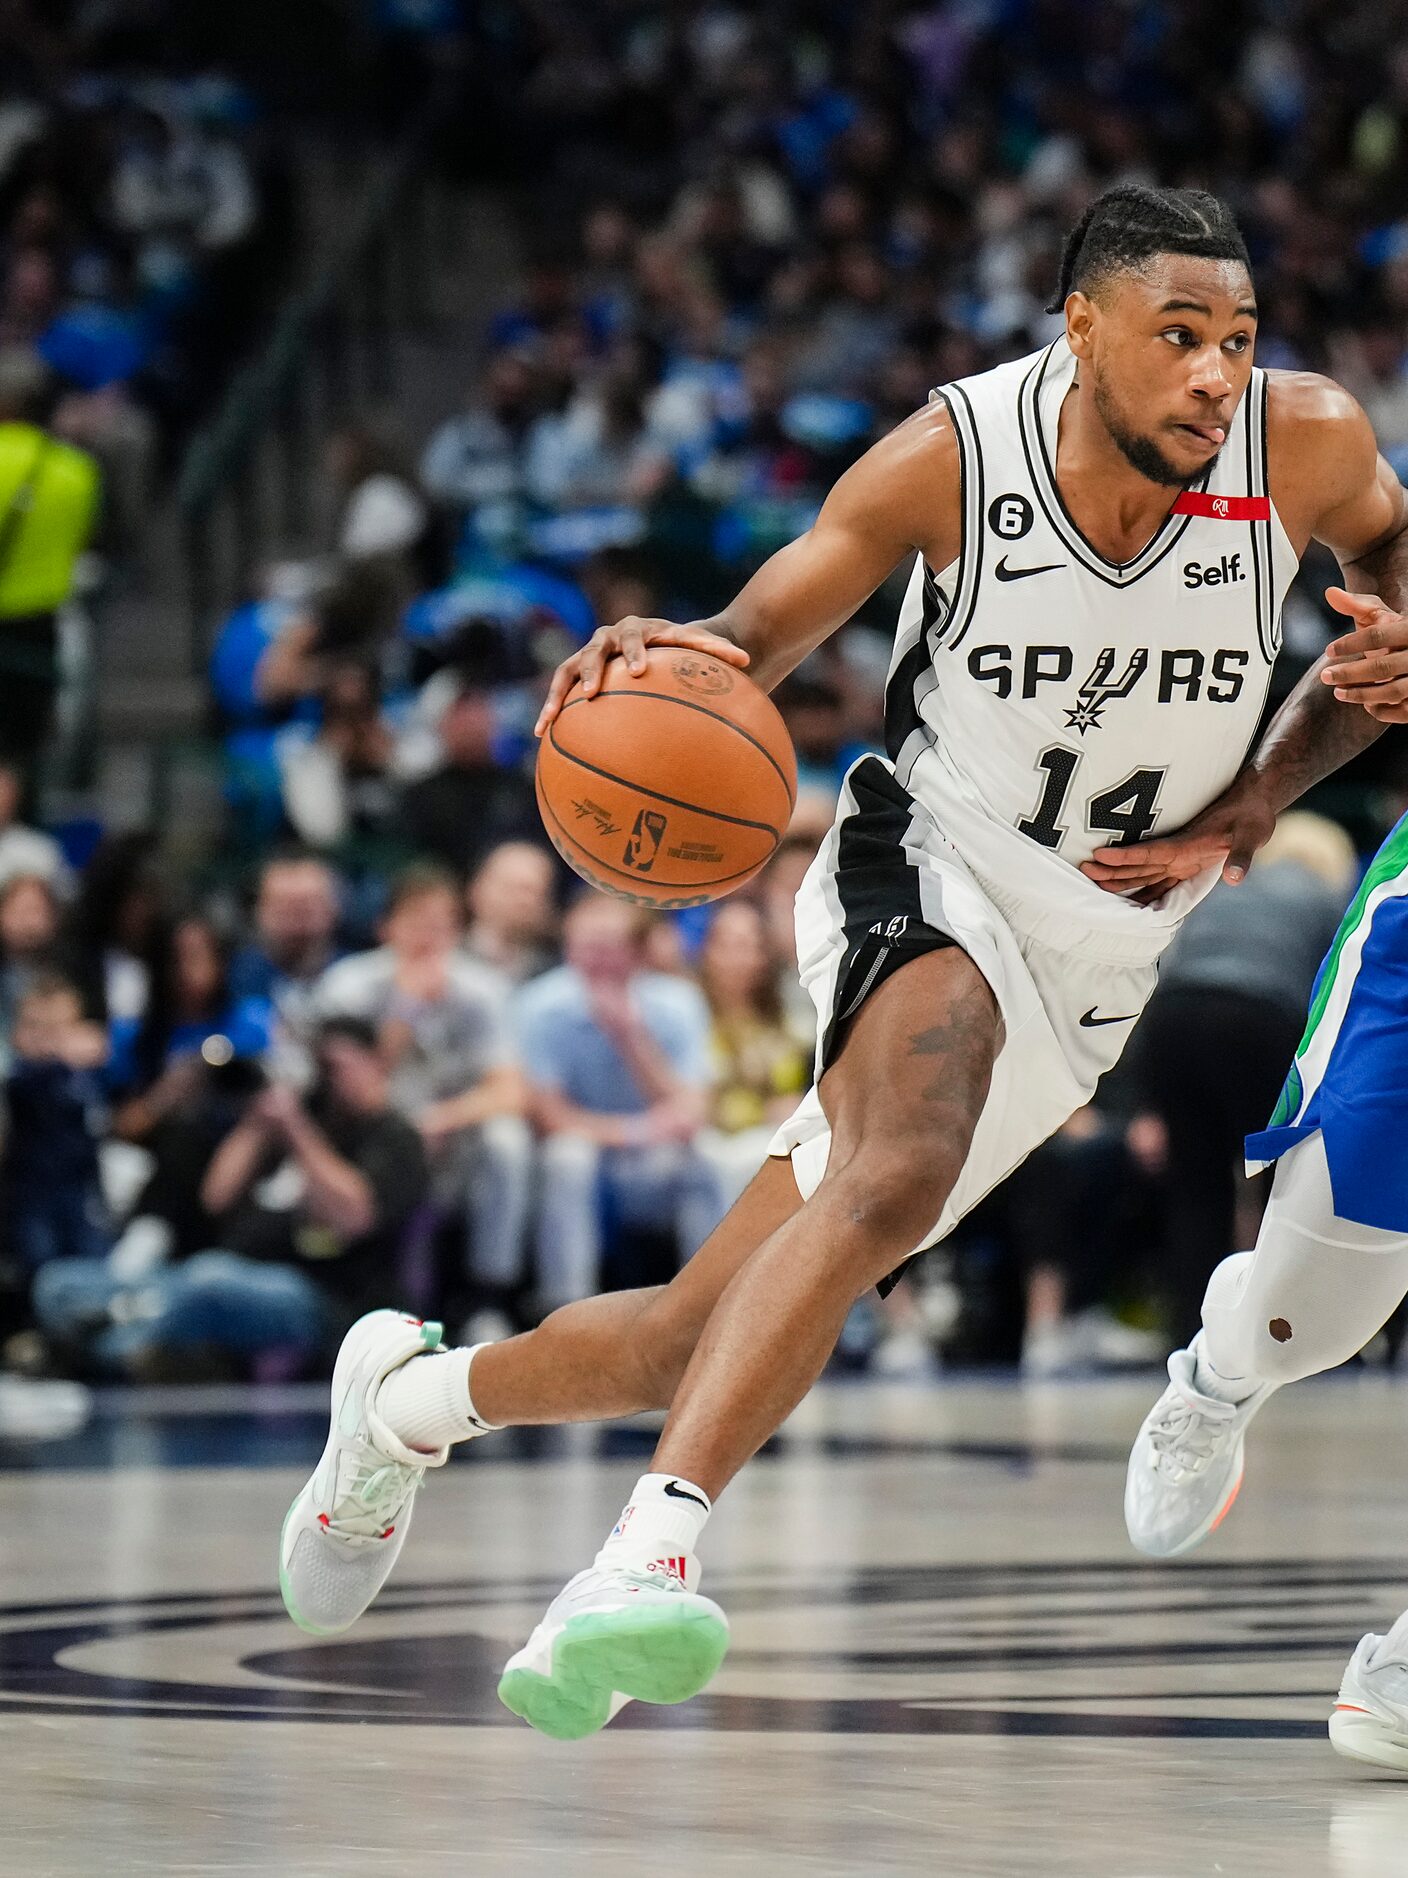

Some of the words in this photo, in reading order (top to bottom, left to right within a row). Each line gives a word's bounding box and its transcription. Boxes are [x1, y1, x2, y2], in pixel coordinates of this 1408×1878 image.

[998, 500, 1024, 534] 6
[1183, 553, 1246, 589] Self.
[967, 645, 1249, 736] SPURS
[1014, 742, 1170, 852] 14
